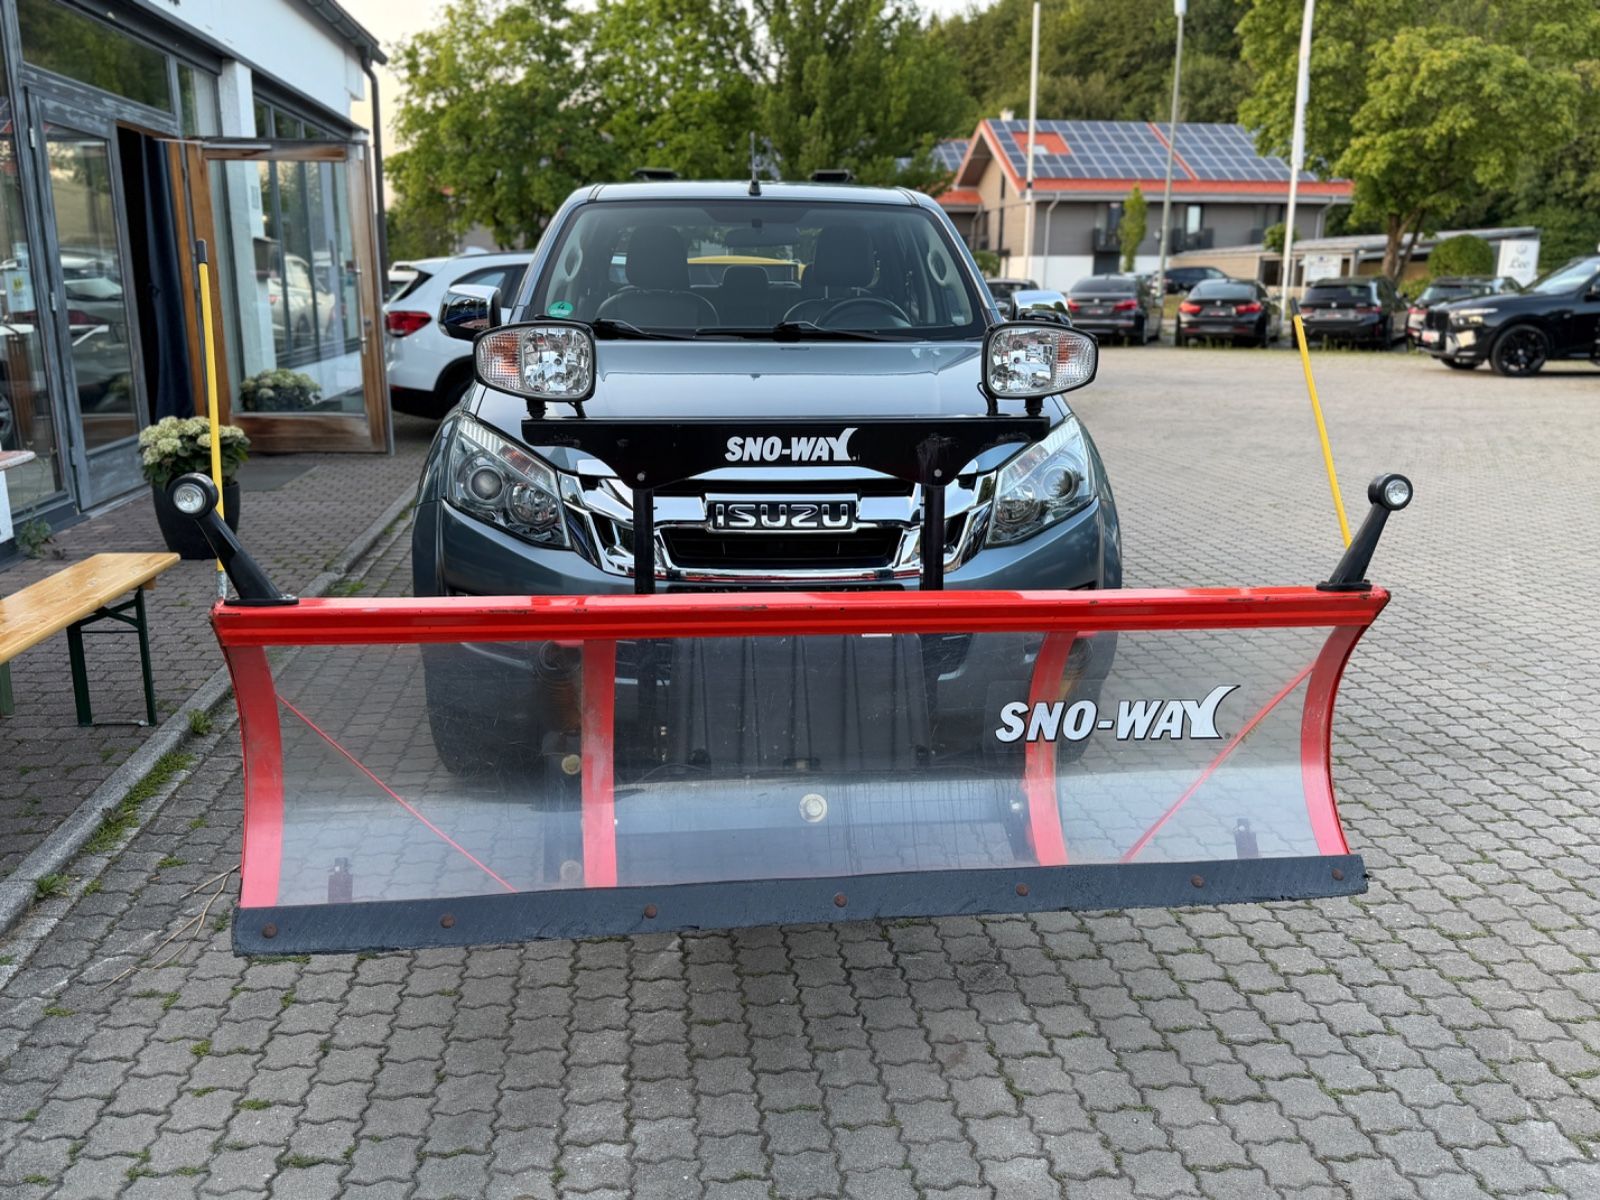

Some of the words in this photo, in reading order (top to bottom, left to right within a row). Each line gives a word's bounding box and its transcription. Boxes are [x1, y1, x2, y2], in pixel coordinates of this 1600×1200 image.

[724, 427, 859, 462] SNO-WAY
[715, 503, 849, 528] ISUZU
[995, 684, 1241, 743] SNO-WAY
